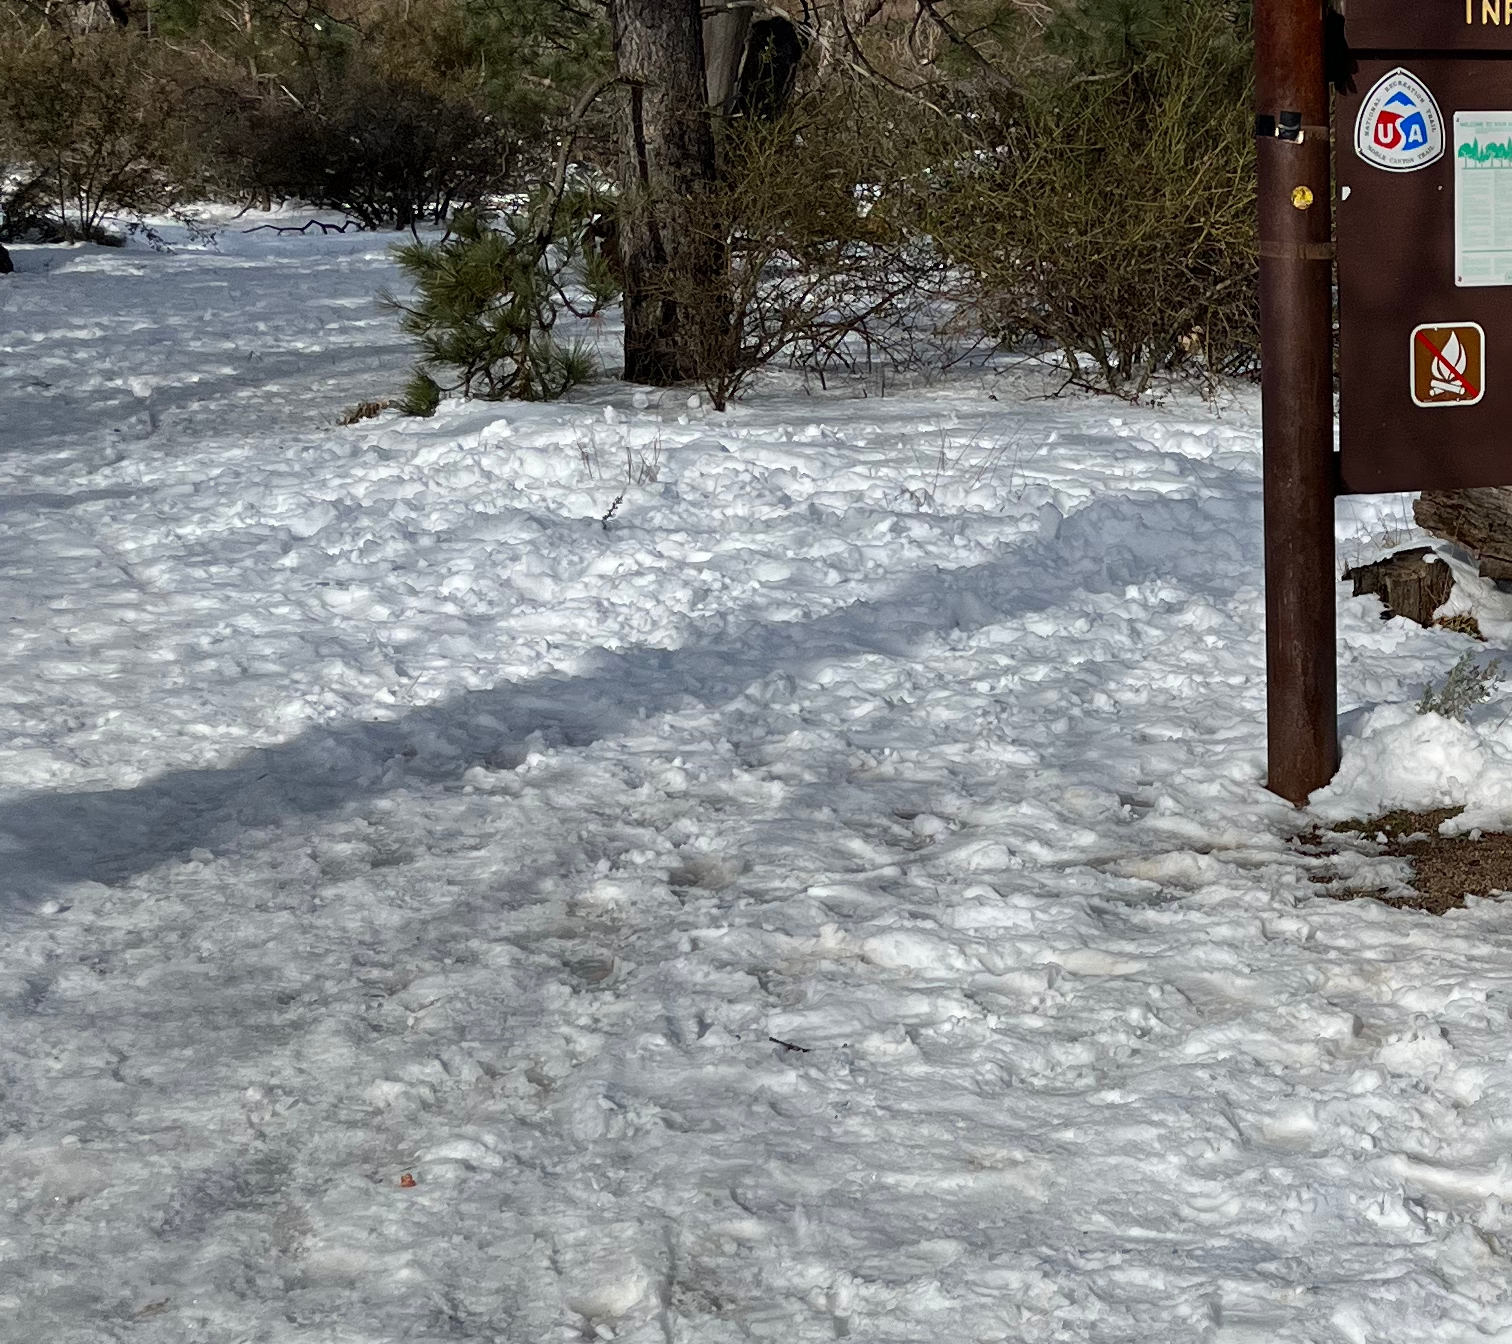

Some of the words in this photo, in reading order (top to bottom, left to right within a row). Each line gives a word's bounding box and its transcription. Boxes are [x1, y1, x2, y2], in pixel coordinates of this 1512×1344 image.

[1384, 80, 1425, 104] RECREATION
[1364, 97, 1382, 137] NATIONAL
[1425, 108, 1437, 133] TRAIL
[1377, 120, 1423, 147] USA
